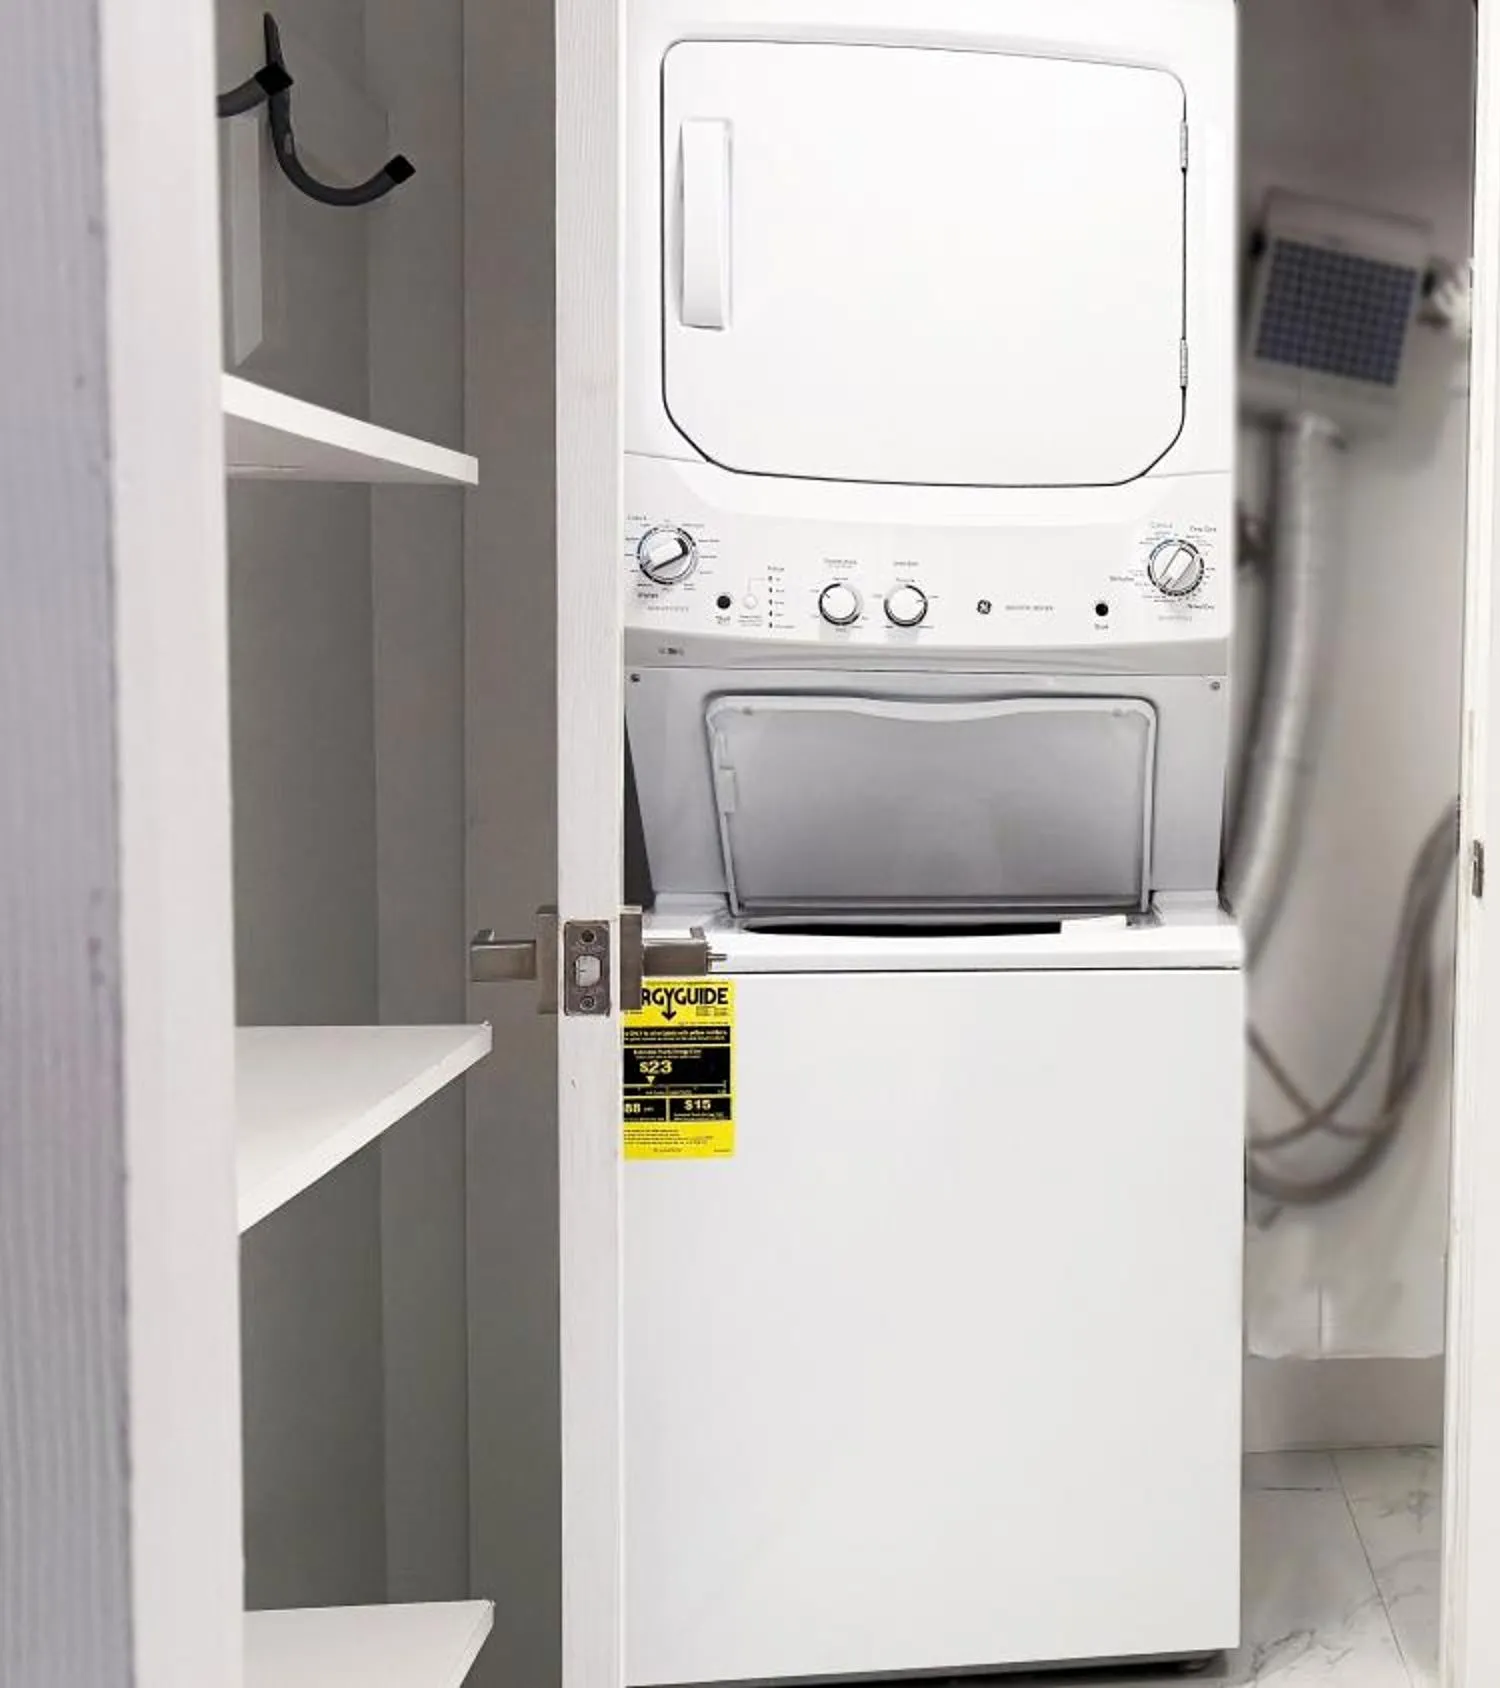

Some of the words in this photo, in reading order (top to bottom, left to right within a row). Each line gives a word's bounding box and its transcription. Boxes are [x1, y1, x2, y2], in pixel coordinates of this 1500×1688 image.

[641, 987, 728, 1005] RGYGUIDE
[639, 1060, 673, 1074] $23
[624, 1103, 641, 1113] 88
[684, 1099, 712, 1111] $15
